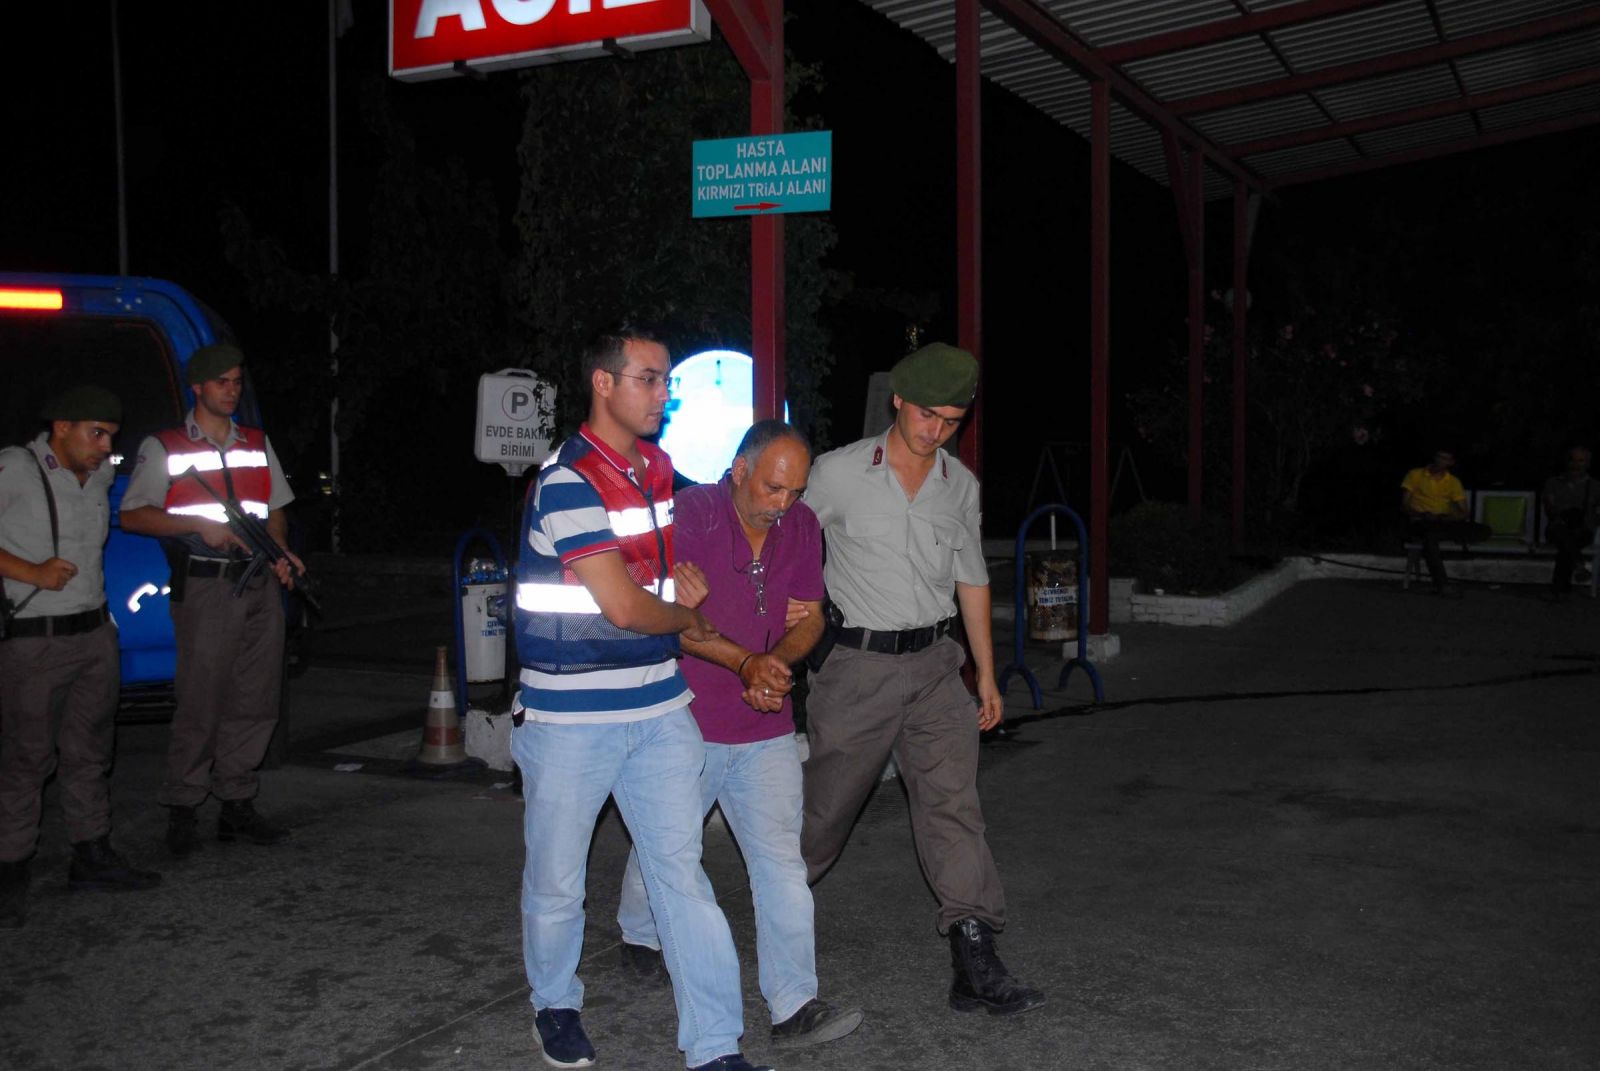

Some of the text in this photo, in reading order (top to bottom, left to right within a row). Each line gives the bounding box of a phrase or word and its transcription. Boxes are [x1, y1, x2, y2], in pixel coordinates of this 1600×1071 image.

[737, 140, 785, 158] HASTA
[697, 157, 827, 181] TOPLANMA ALANI
[697, 183, 744, 201] KIRMIZI
[786, 179, 826, 196] ALANI
[511, 392, 529, 414] P
[486, 425, 514, 438] EVDE
